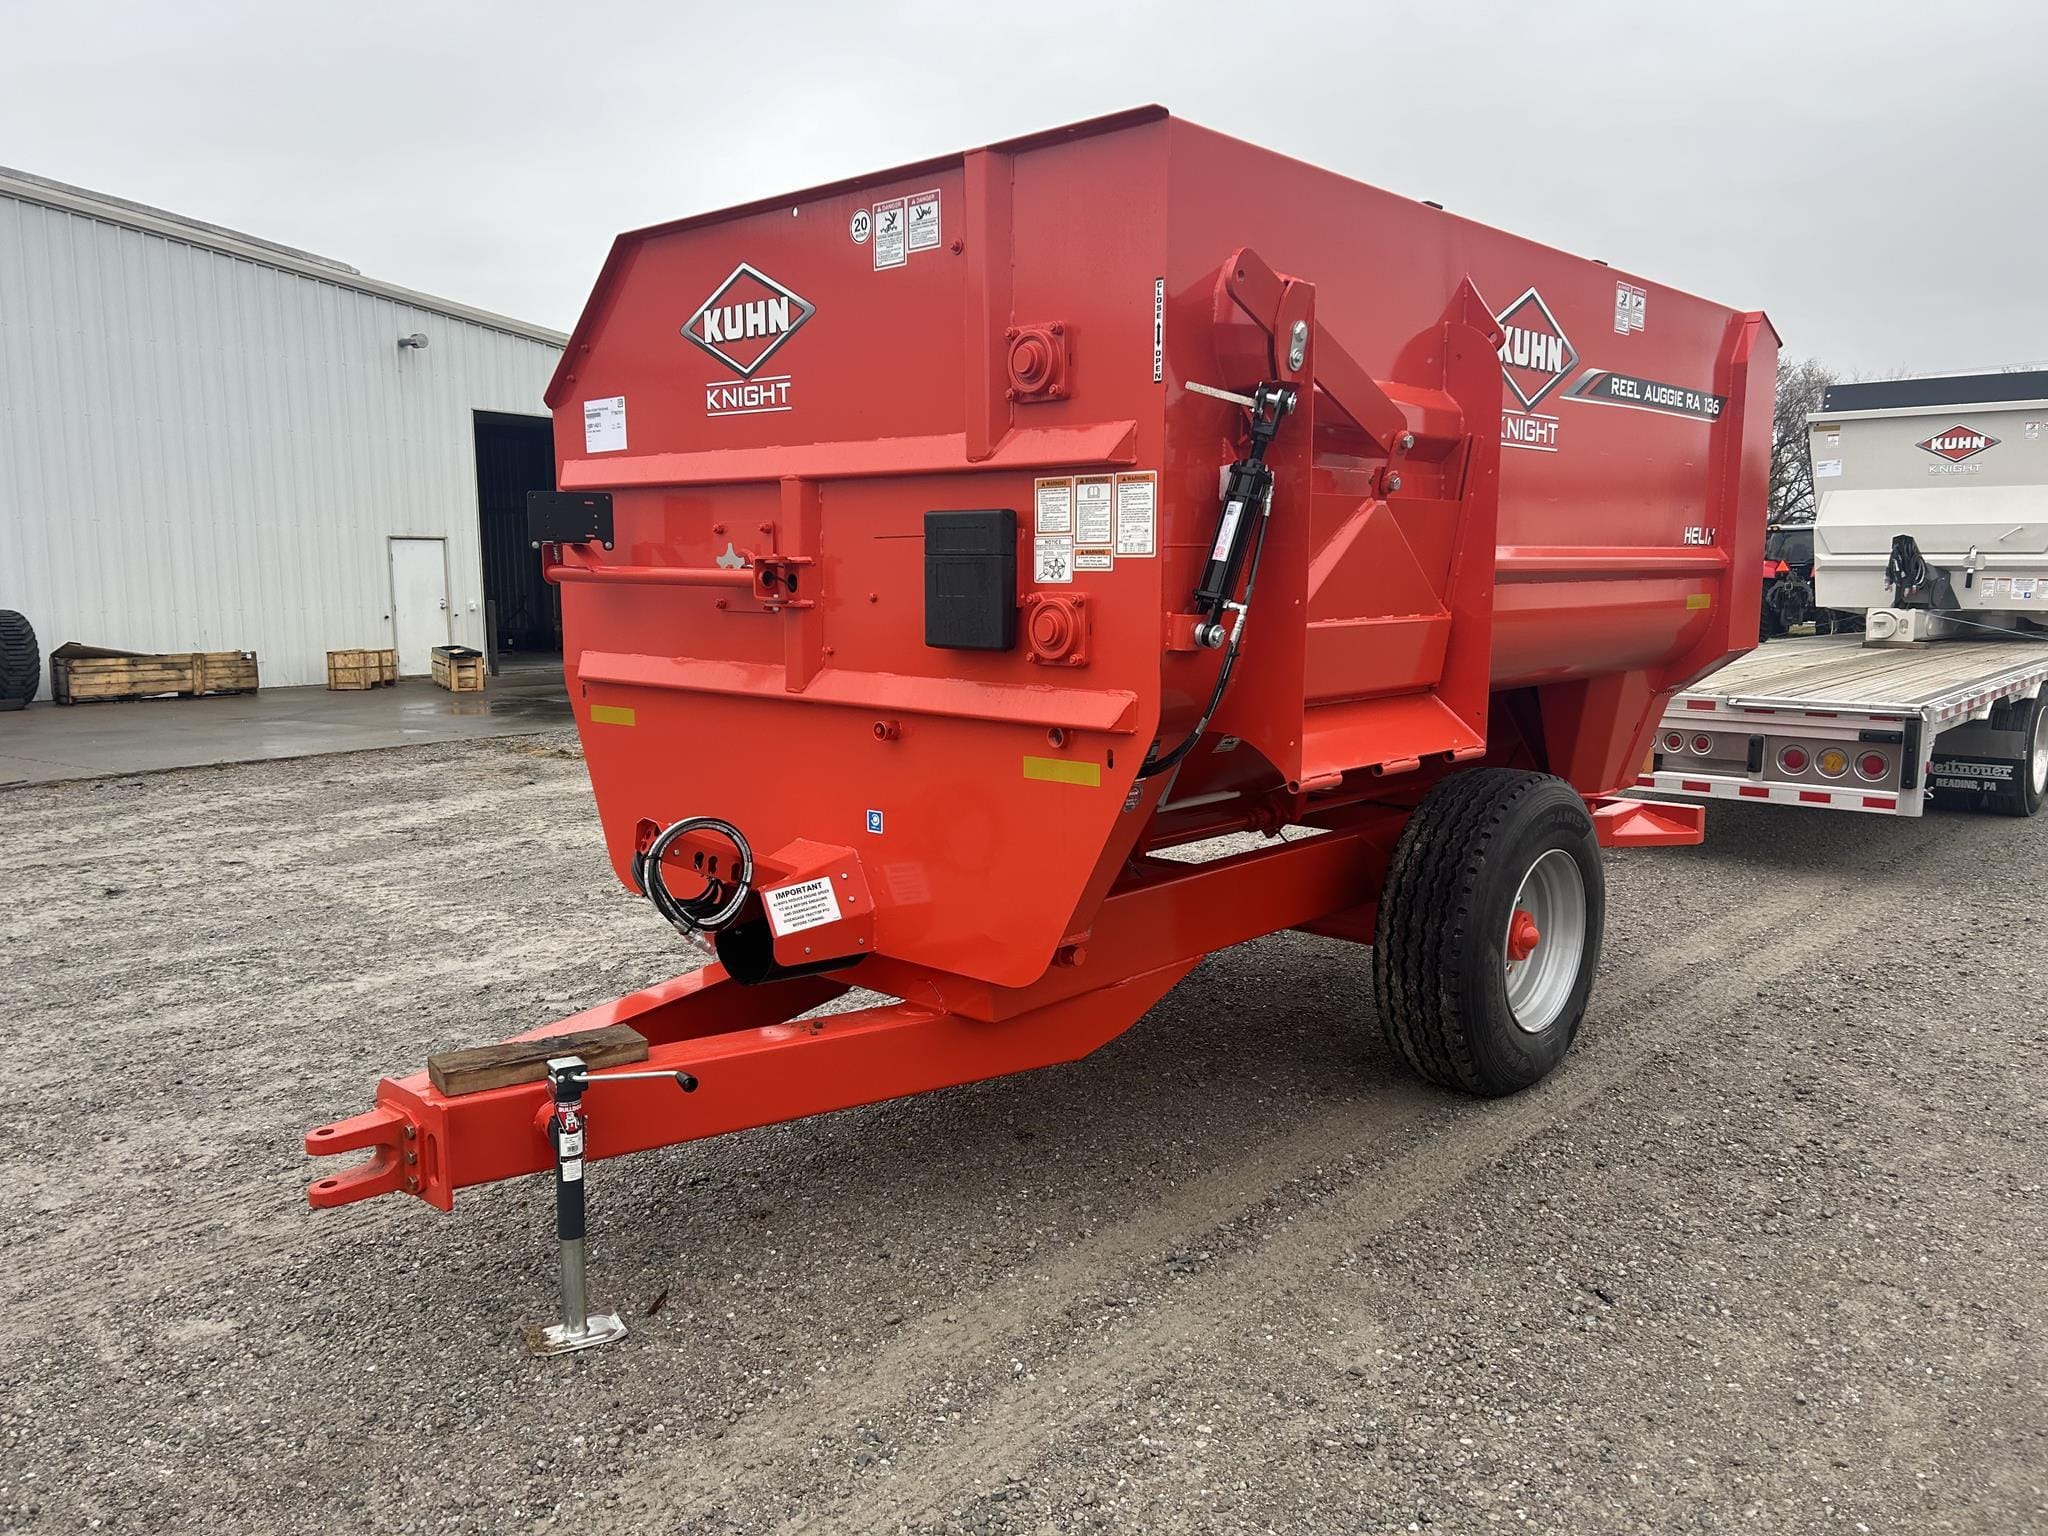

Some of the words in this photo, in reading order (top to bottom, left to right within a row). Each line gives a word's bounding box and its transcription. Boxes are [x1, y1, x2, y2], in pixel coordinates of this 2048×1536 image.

[854, 216, 868, 232] 20
[703, 296, 789, 343] KUHN
[706, 382, 791, 410] KNIGHT
[1611, 377, 1641, 399] REEL
[1644, 384, 1684, 407] AUGGIE
[1686, 393, 1700, 410] RA
[1704, 397, 1720, 414] 136
[1931, 436, 1986, 450] KUHN
[1929, 463, 1983, 473] KNIGHT
[1983, 781, 1997, 791] PA
[775, 881, 822, 900] IMPORTANT
